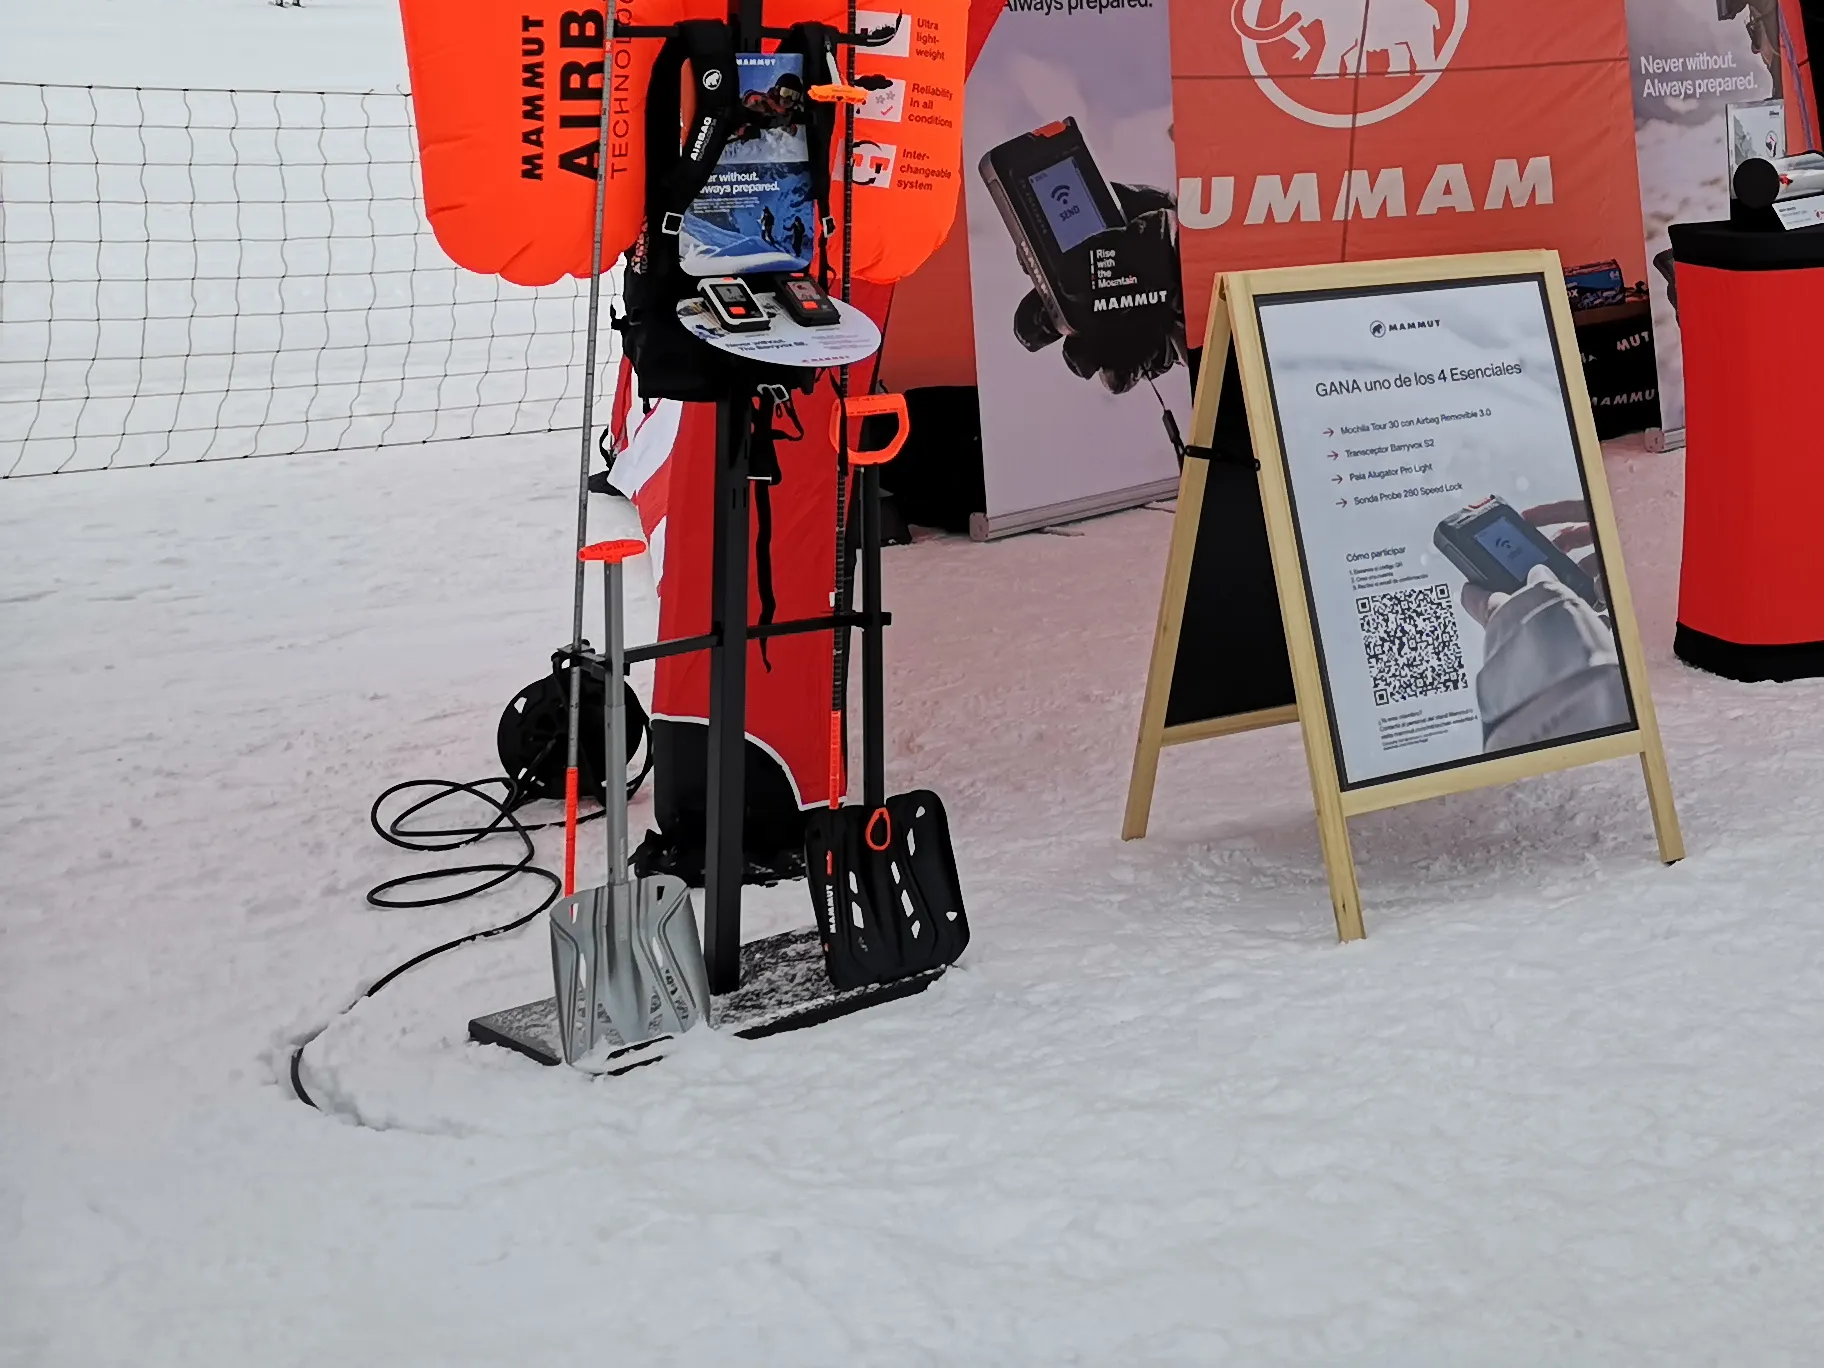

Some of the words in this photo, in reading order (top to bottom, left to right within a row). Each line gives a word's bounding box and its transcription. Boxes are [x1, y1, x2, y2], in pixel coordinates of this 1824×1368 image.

[917, 18, 939, 31] Ultra
[916, 31, 940, 47] light-
[916, 47, 945, 61] weight
[1640, 55, 1684, 74] Never
[1686, 51, 1737, 71] without.
[911, 83, 953, 101] Reliability
[1643, 78, 1694, 100] Always
[1696, 72, 1758, 98] prepared.
[521, 15, 545, 182] MAMMUT
[910, 98, 919, 108] in
[921, 98, 934, 110] all
[908, 113, 952, 129] conditions
[902, 149, 930, 161] Inter-
[718, 171, 760, 183] without.
[899, 164, 952, 180] changeable
[733, 181, 780, 195] prepared.
[897, 179, 933, 191] system
[1097, 249, 1116, 259] Rise
[1097, 258, 1115, 268] with
[1097, 269, 1112, 278] the
[1098, 275, 1138, 289] Mountain
[1093, 290, 1168, 312] MAMMUT
[1389, 319, 1441, 332] MAMMUT
[1315, 379, 1362, 398] GANA
[1364, 379, 1391, 392] uno
[1394, 373, 1412, 389] de
[1414, 371, 1435, 386] los
[1437, 369, 1447, 383] 4
[1449, 361, 1522, 382] Esenciales
[1340, 424, 1370, 435] Mochila
[1371, 421, 1388, 432] Tour
[1388, 420, 1399, 429] 30
[1400, 418, 1415, 428] con
[1416, 414, 1440, 427] Airbag
[1479, 408, 1492, 417] 3.0
[1424, 439, 1435, 448] S2
[1400, 465, 1412, 476] Pro
[1413, 462, 1433, 475] Light
[1354, 495, 1378, 506] Sonda
[1379, 491, 1402, 502] Probe
[1420, 484, 1444, 497] Speed
[1445, 482, 1463, 493] Lock
[1346, 552, 1369, 563] Cómo
[1371, 547, 1406, 560] participar
[825, 884, 837, 933] MAMMUT
